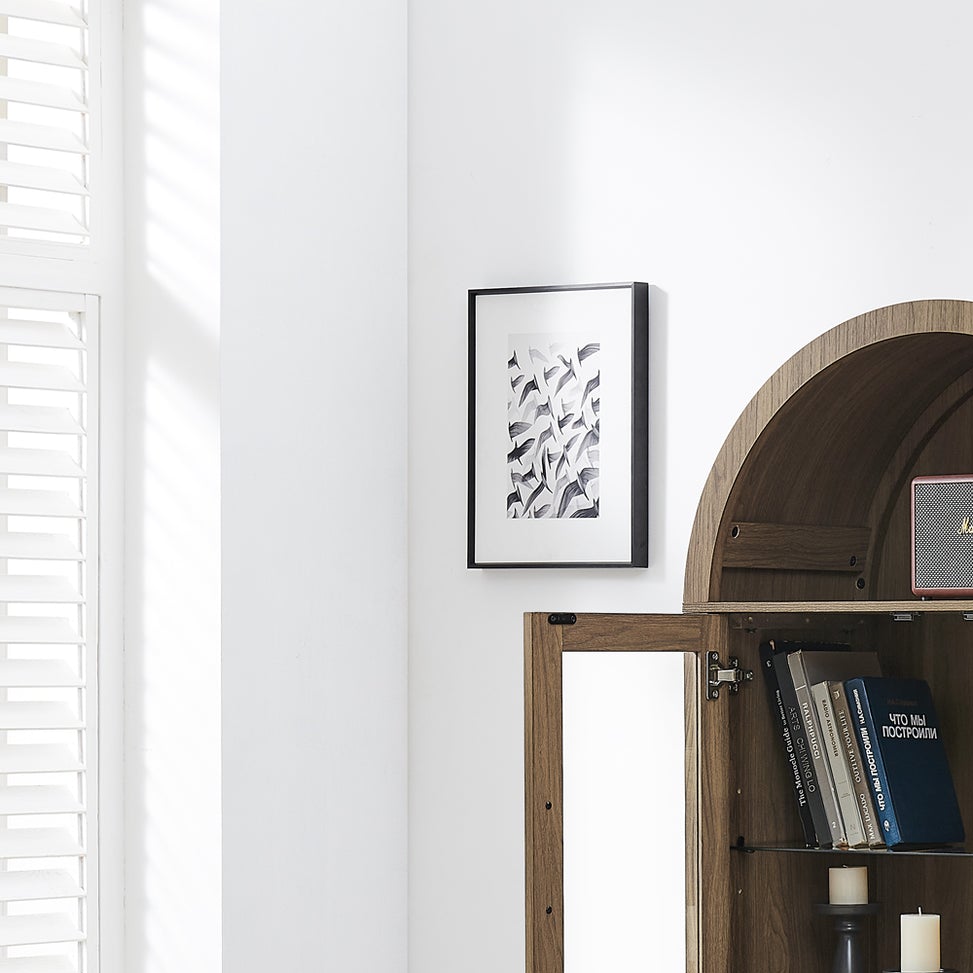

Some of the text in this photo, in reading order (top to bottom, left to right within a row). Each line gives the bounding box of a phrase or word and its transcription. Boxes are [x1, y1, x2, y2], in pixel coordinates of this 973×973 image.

[788, 706, 801, 731] ARTS
[821, 699, 839, 757] RADIO ASTRONOMER
[838, 709, 848, 727] LIFE
[889, 713, 927, 727] ЧТО МЫ
[783, 727, 794, 752] Guide
[843, 727, 853, 749] YOUR
[882, 725, 938, 739] ПОСТРОИЛИ
[860, 727, 878, 776] ПОСТРОИЛИ
[788, 753, 803, 789] Monocle
[800, 754, 813, 779] WING
[848, 749, 861, 783] OUTLIVE
[806, 777, 816, 793] LO
[872, 777, 882, 792] МЫ
[797, 789, 807, 807] The
[859, 793, 871, 822] LUCADO
[876, 793, 886, 811] ЧТО
